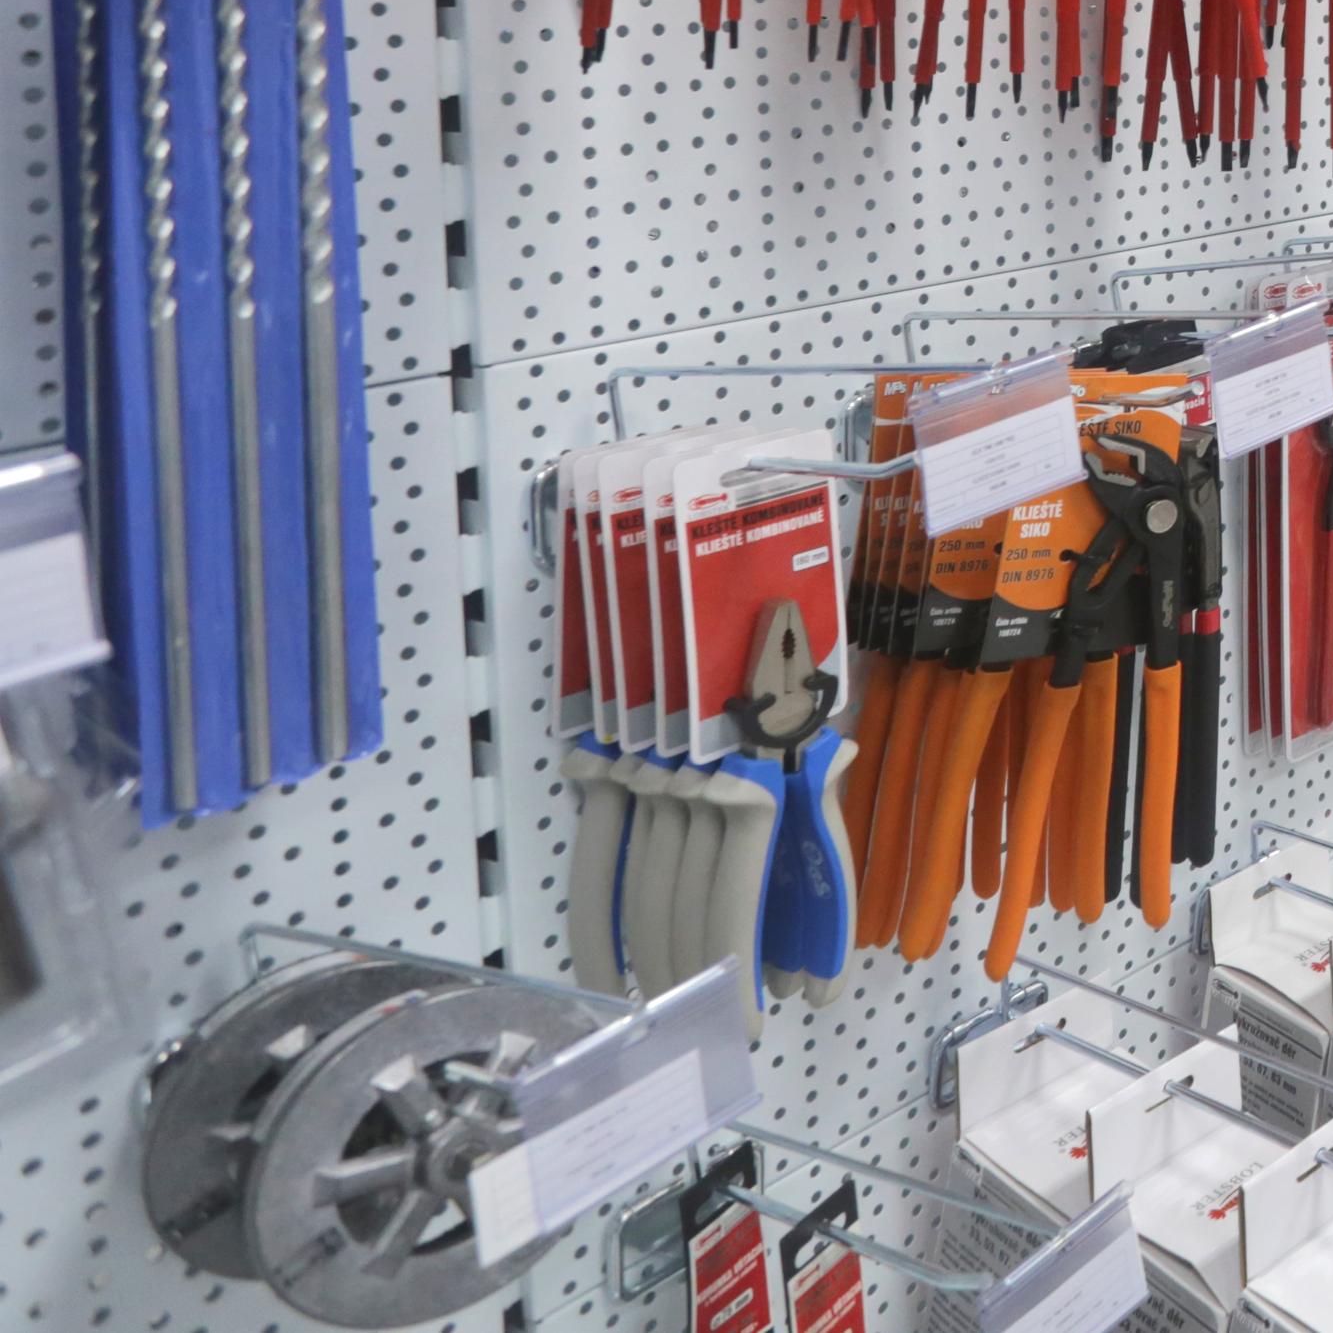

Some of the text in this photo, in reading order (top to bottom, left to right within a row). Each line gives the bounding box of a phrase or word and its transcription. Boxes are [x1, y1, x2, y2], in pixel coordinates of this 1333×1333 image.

[1114, 420, 1142, 436] SIKO
[1020, 522, 1051, 540] SIKO
[938, 539, 961, 553] 250
[1006, 548, 1051, 562] 250 mm
[1002, 569, 1054, 584] DIN 8976
